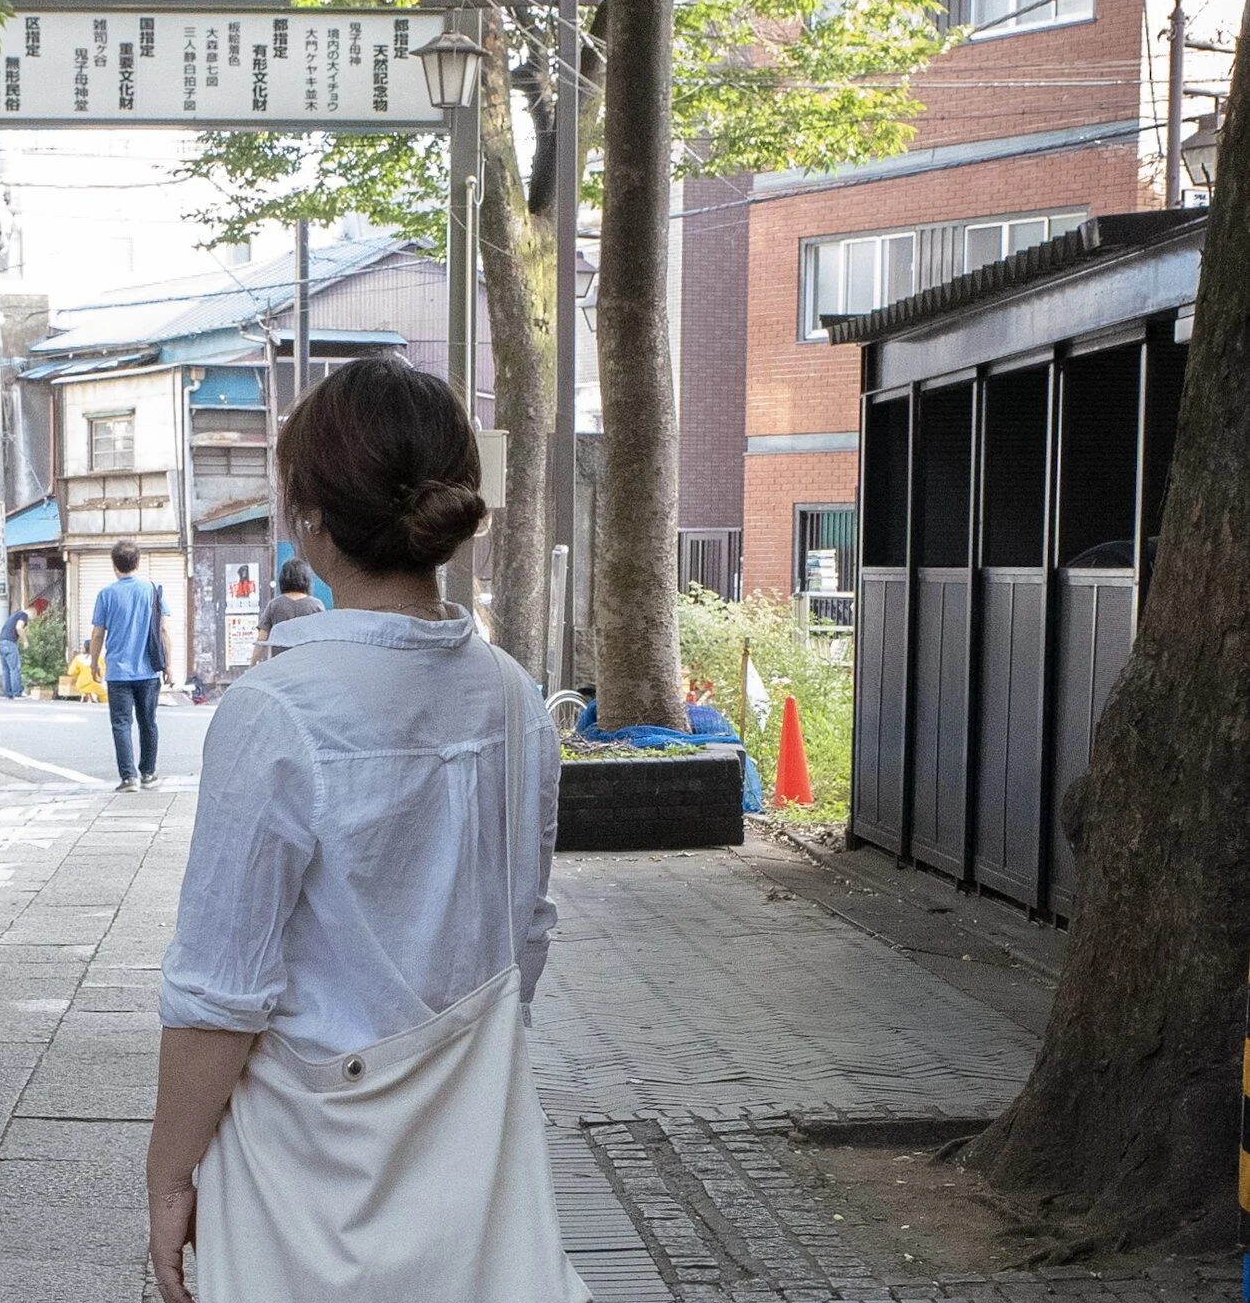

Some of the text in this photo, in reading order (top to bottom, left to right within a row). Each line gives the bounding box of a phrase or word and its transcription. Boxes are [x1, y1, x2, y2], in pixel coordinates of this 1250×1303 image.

[25, 17, 40, 57] 区指定
[140, 17, 154, 57] 国指定
[206, 28, 218, 87] 大森彦七図
[273, 18, 288, 59] 都指定
[349, 22, 362, 66] 鬼子母神
[394, 19, 409, 59] 都指定
[5, 57, 20, 111] 無形民俗
[74, 48, 89, 112] 鬼子母神堂
[119, 42, 134, 110] 重要文化財
[184, 27, 196, 111] 三人静白拍子図
[252, 44, 268, 112] 有形文化財
[305, 28, 318, 112] 大門ケヤキ並木
[327, 28, 339, 112] 境内の大イチョウ
[373, 45, 388, 112] 天然記念物
